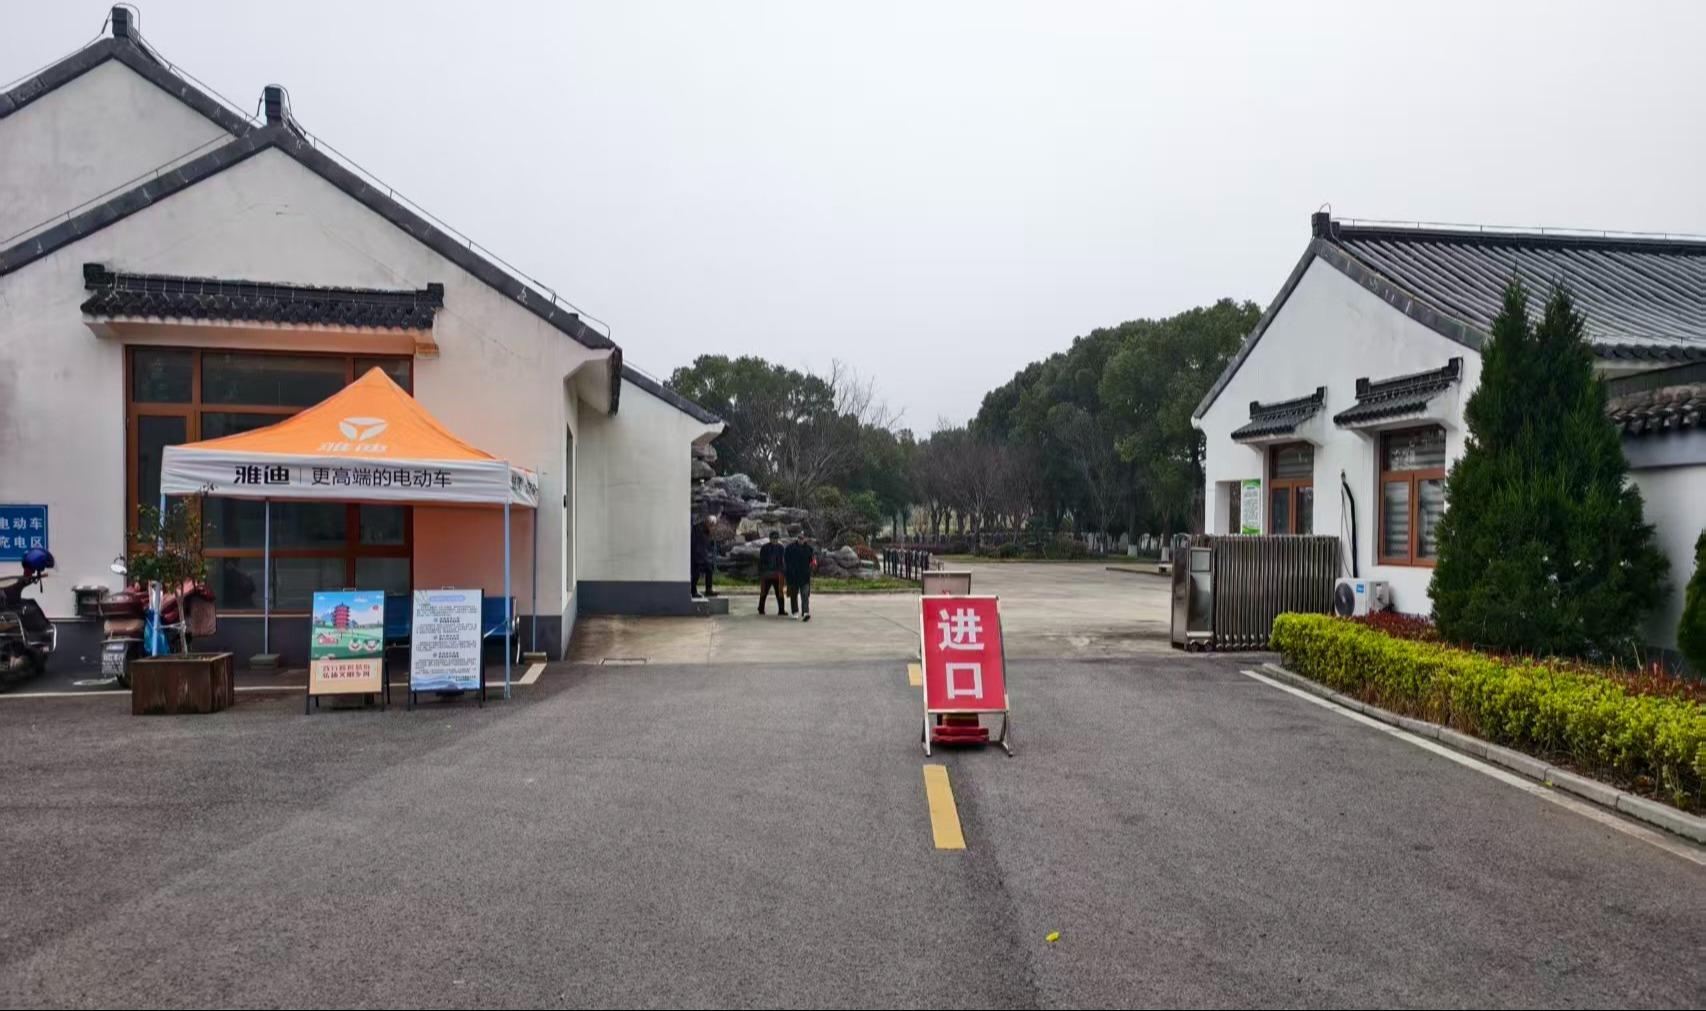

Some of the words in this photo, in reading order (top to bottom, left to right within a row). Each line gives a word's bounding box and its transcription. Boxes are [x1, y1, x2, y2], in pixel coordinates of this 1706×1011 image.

[233, 465, 291, 485] 雅迪
[311, 466, 453, 488] 更高端的电动车
[0, 516, 43, 531] 电动车
[0, 534, 43, 549] 充电区
[937, 608, 985, 700] 进口
